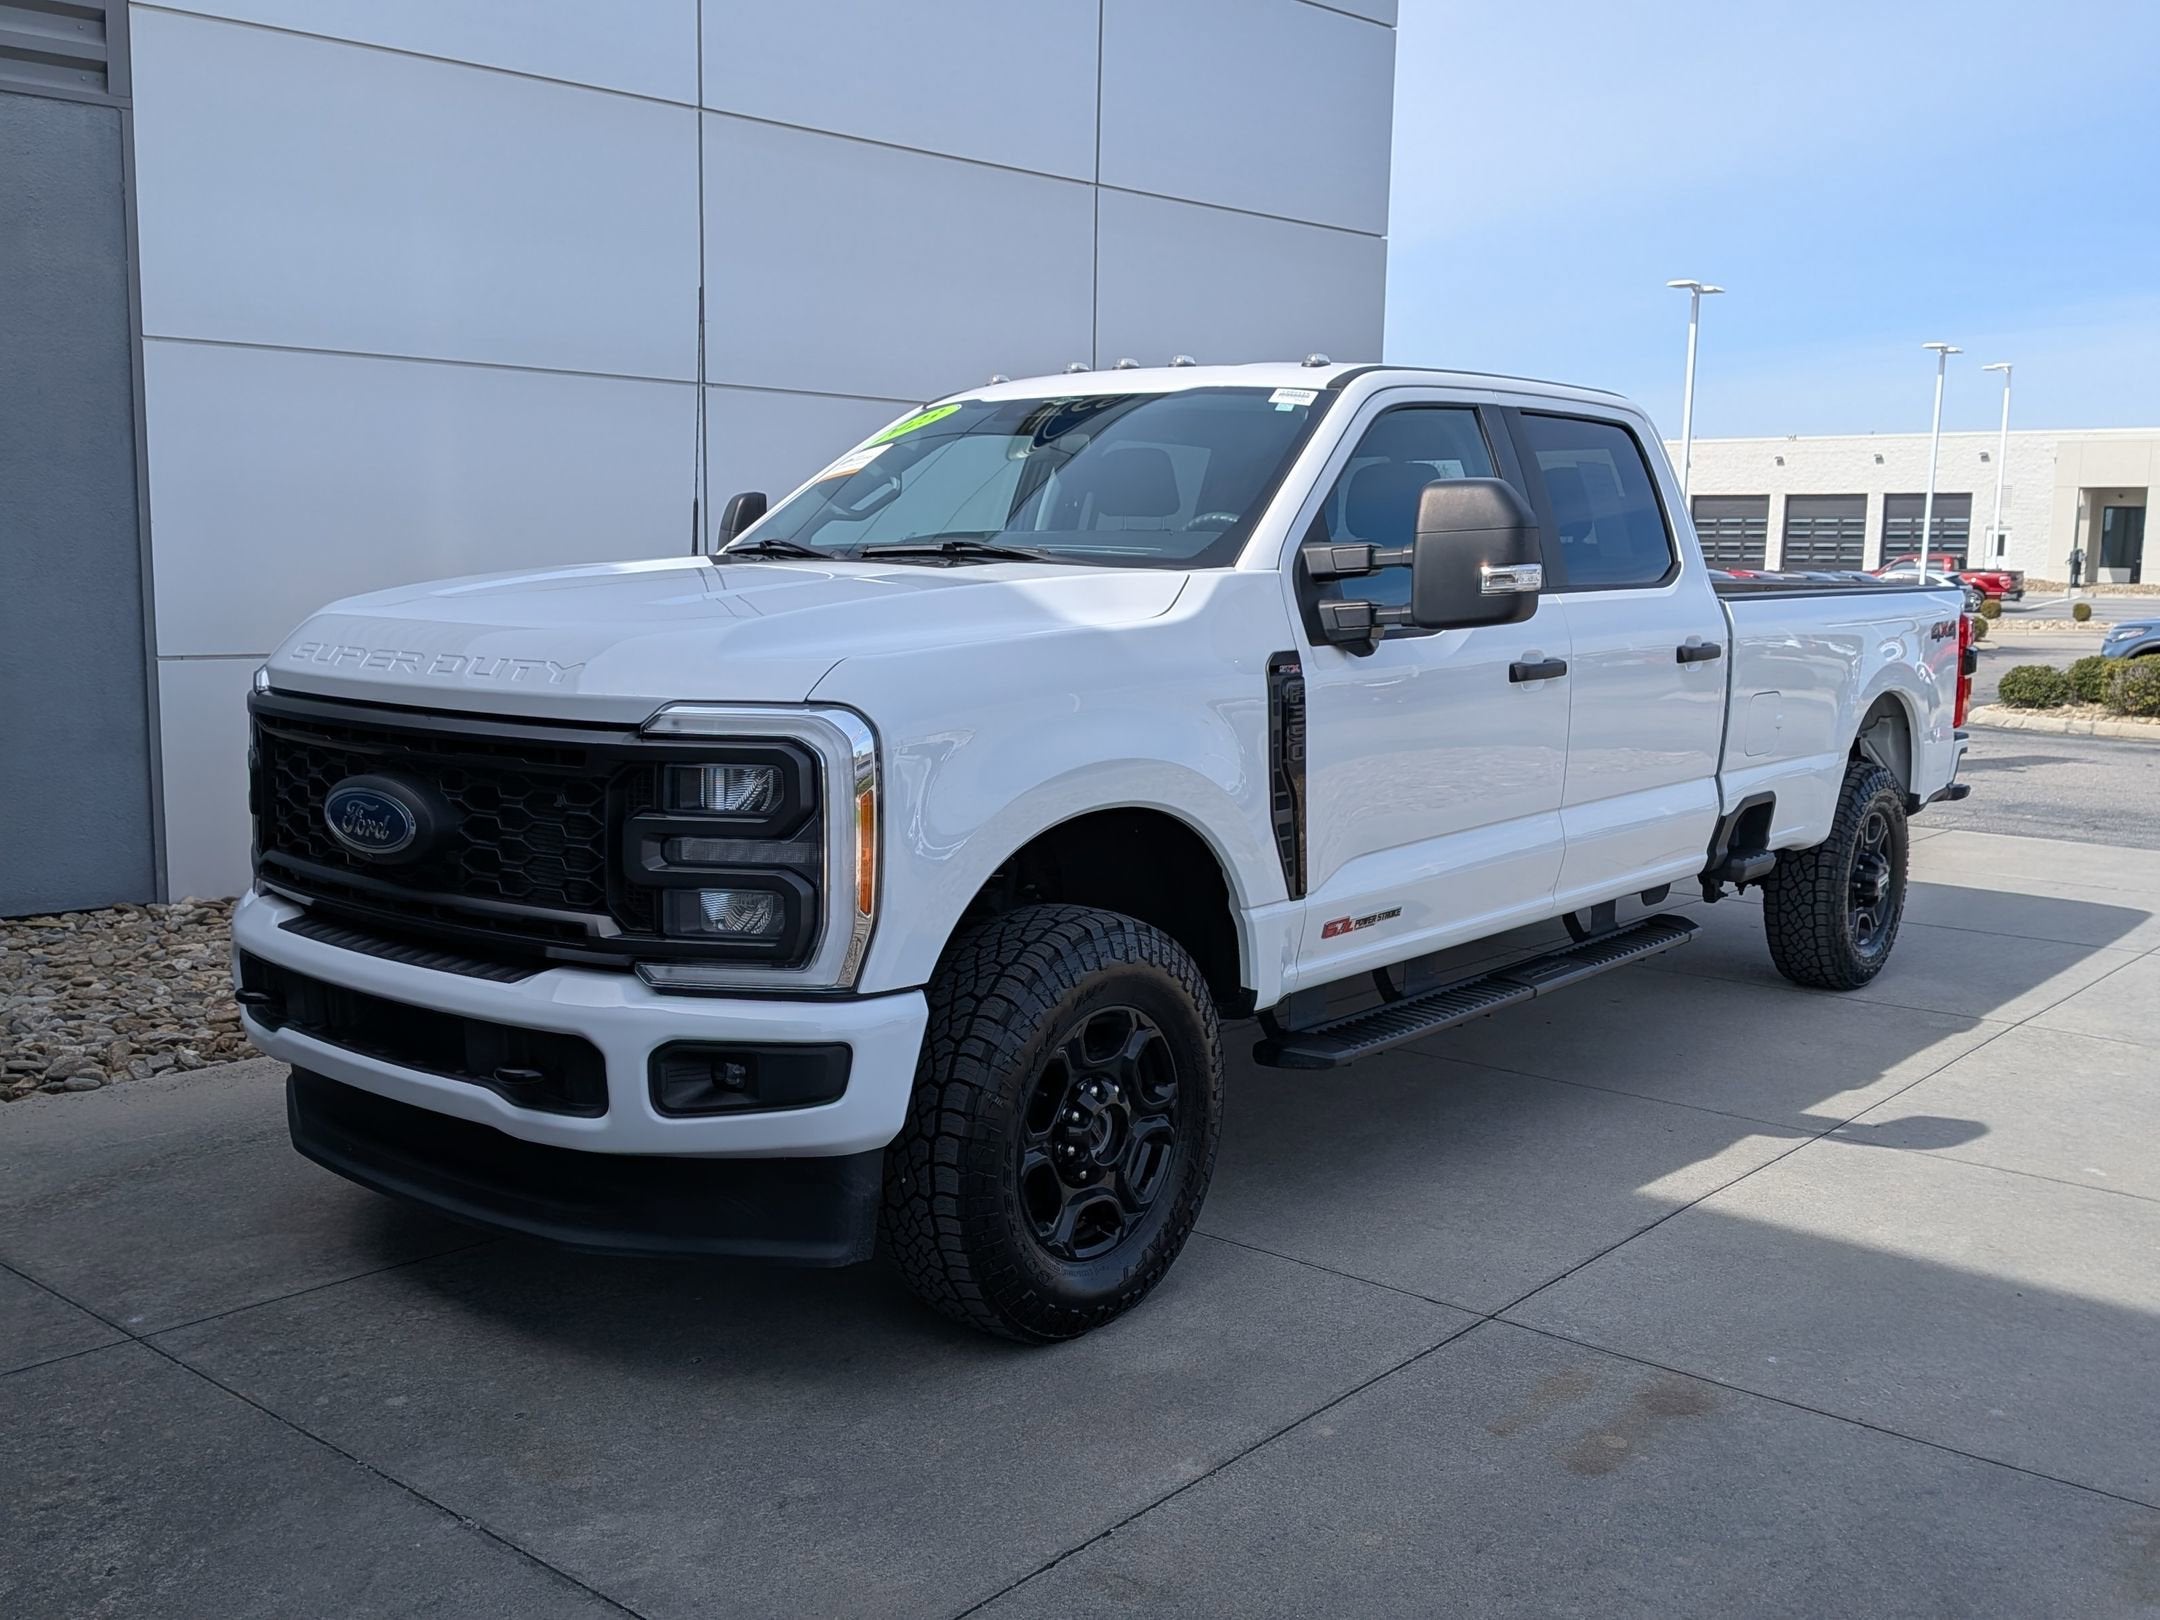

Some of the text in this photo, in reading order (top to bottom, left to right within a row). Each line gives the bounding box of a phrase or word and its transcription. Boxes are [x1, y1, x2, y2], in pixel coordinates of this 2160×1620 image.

[289, 641, 587, 685] SUPER DUTY
[341, 799, 390, 840] Ford
[1354, 914, 1378, 927] POWER
